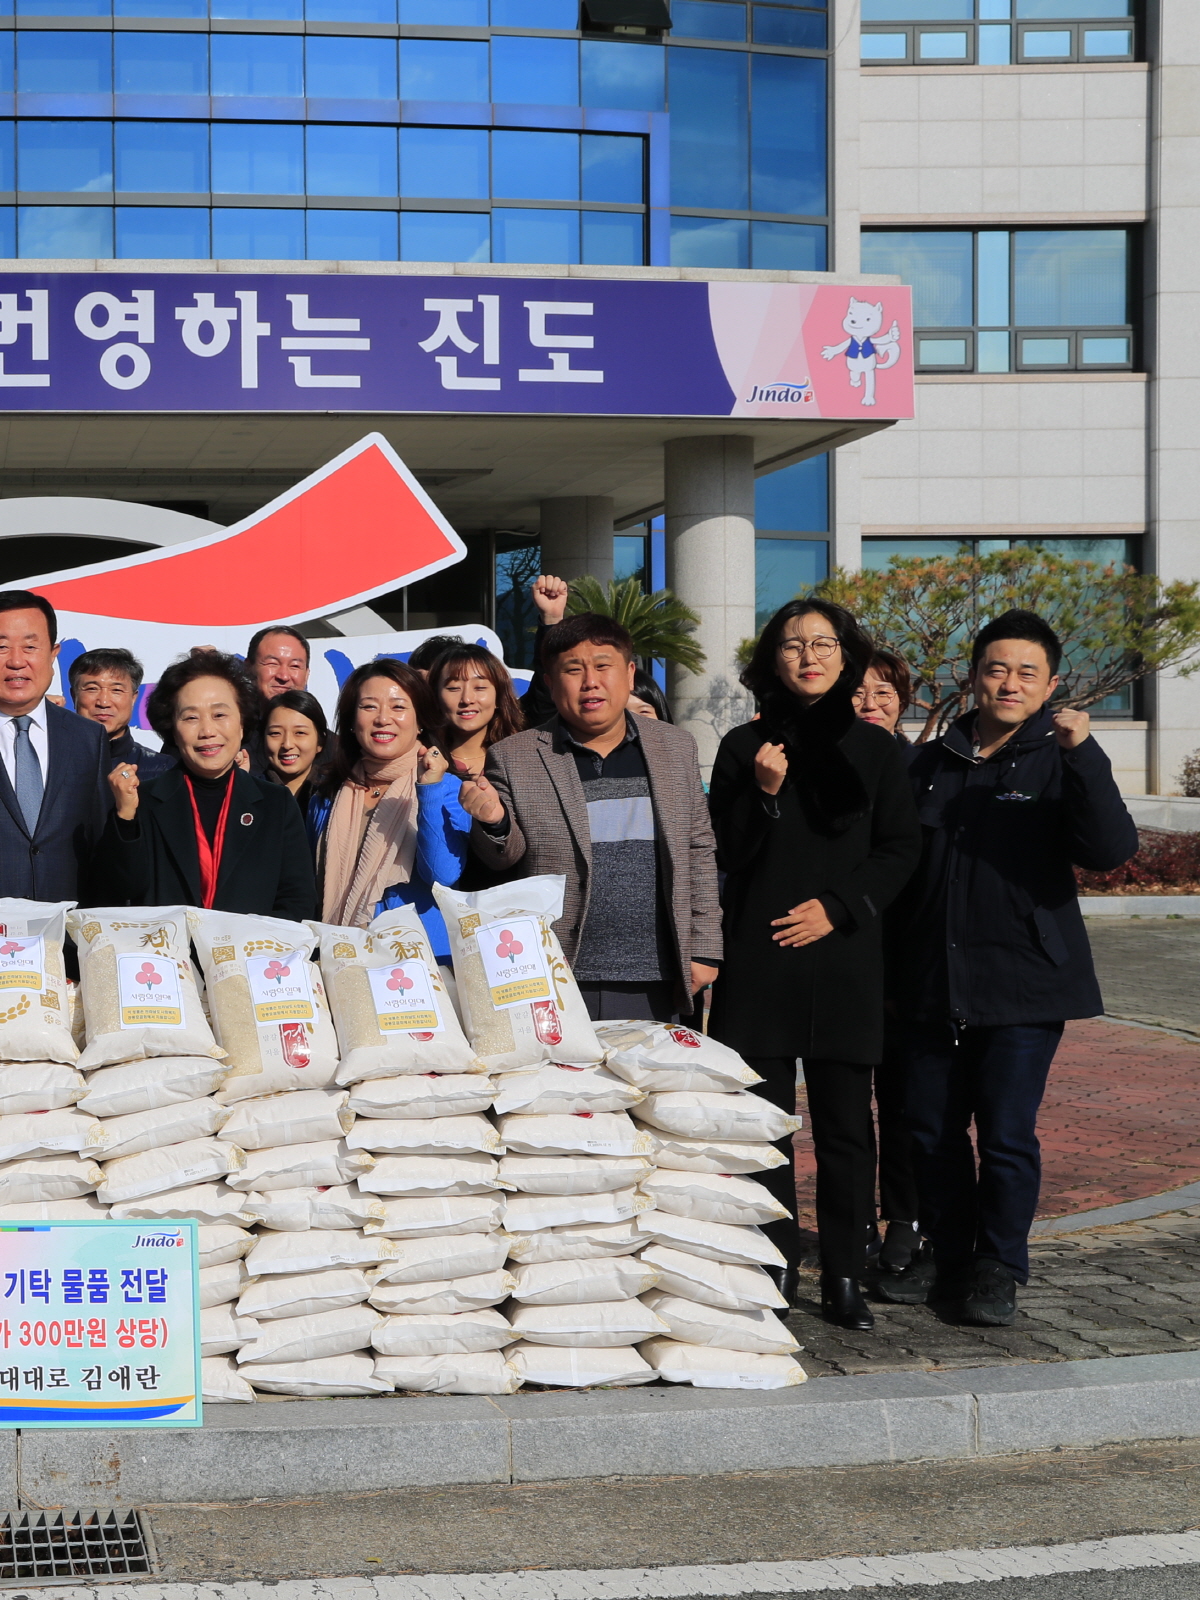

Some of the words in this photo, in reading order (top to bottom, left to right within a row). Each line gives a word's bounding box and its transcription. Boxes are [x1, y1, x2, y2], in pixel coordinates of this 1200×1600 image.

[418, 294, 604, 391] 진도
[745, 385, 802, 403] Jindo
[131, 1235, 175, 1248] Jindo
[4, 1268, 52, 1305] 기탁
[61, 1268, 110, 1304] 물품
[120, 1267, 168, 1303] 전달
[20, 1319, 107, 1348] 300만원
[116, 1317, 169, 1348] 상당)
[81, 1364, 161, 1391] 김애란
